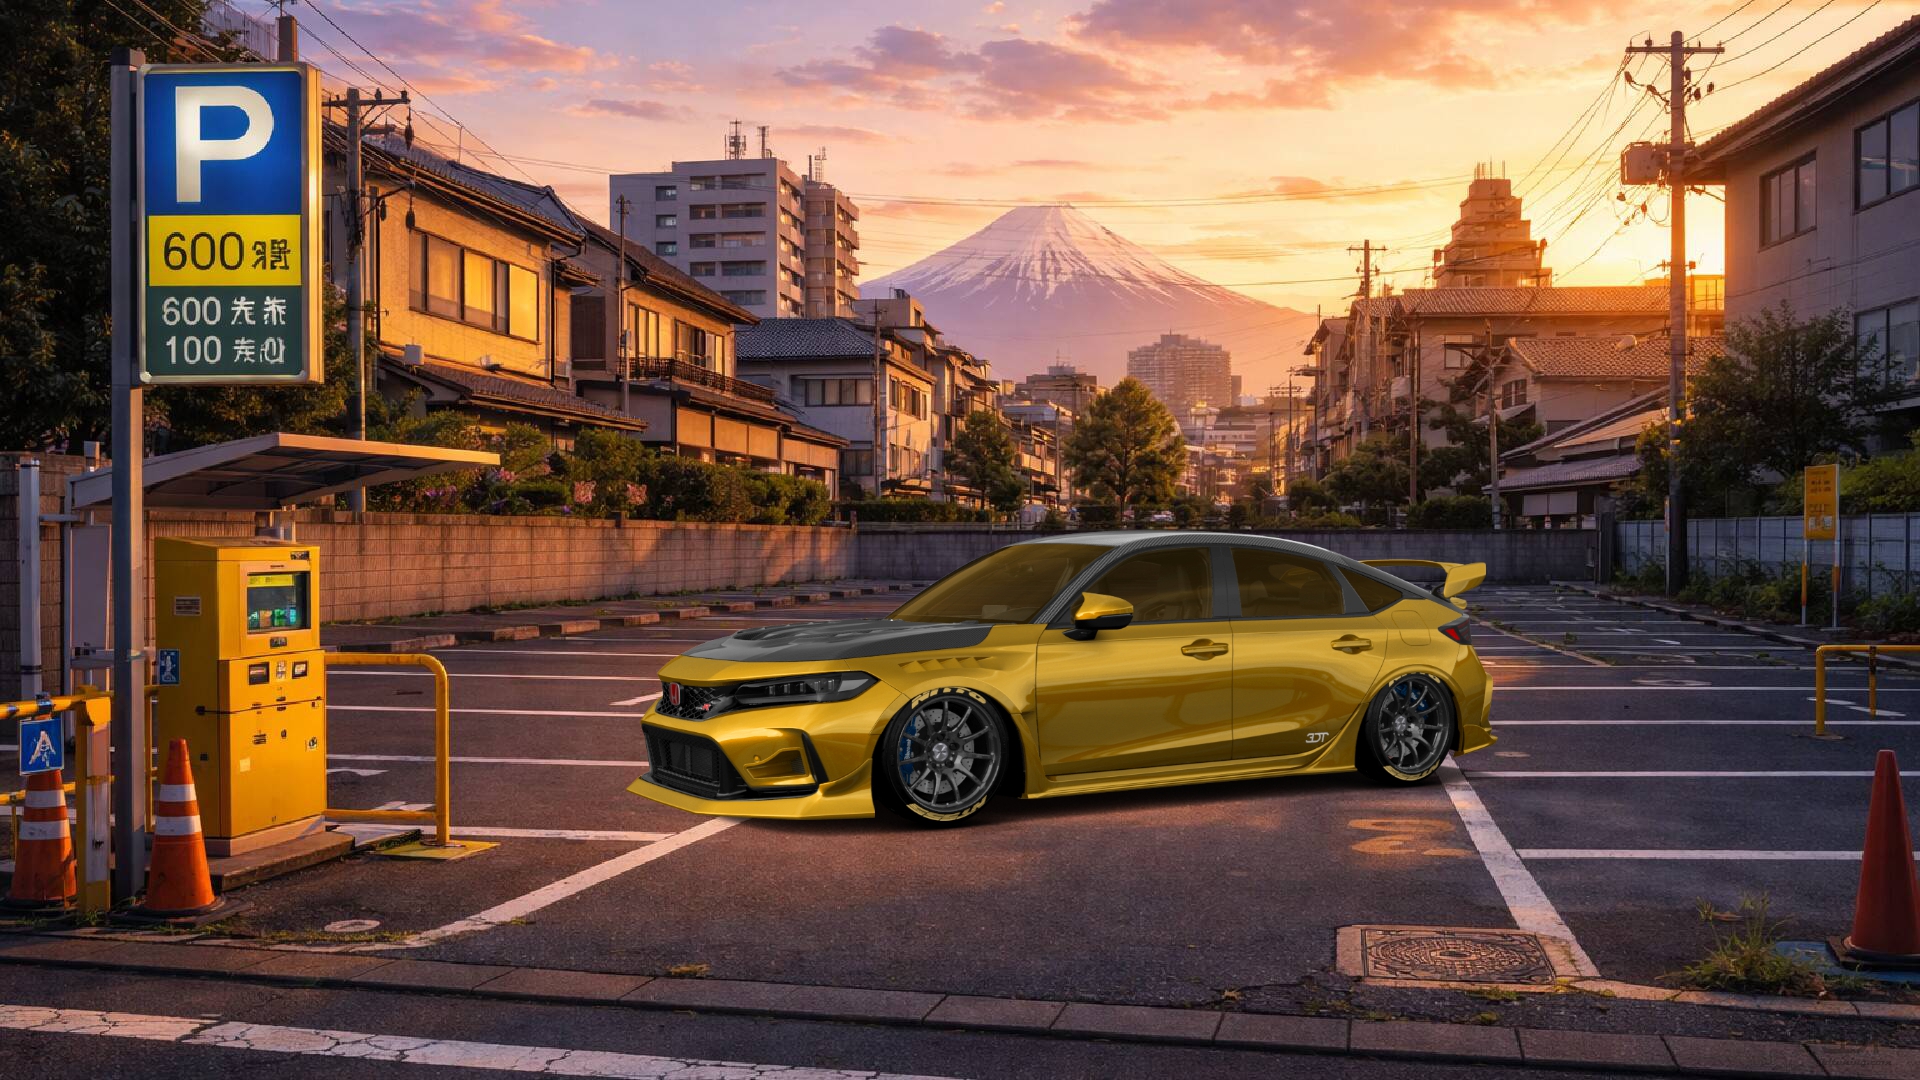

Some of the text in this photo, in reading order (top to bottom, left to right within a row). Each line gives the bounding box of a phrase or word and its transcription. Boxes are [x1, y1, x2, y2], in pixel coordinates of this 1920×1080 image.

[175, 85, 274, 203] P
[164, 231, 245, 271] 600
[162, 296, 222, 326] 600
[166, 335, 222, 365] 100
